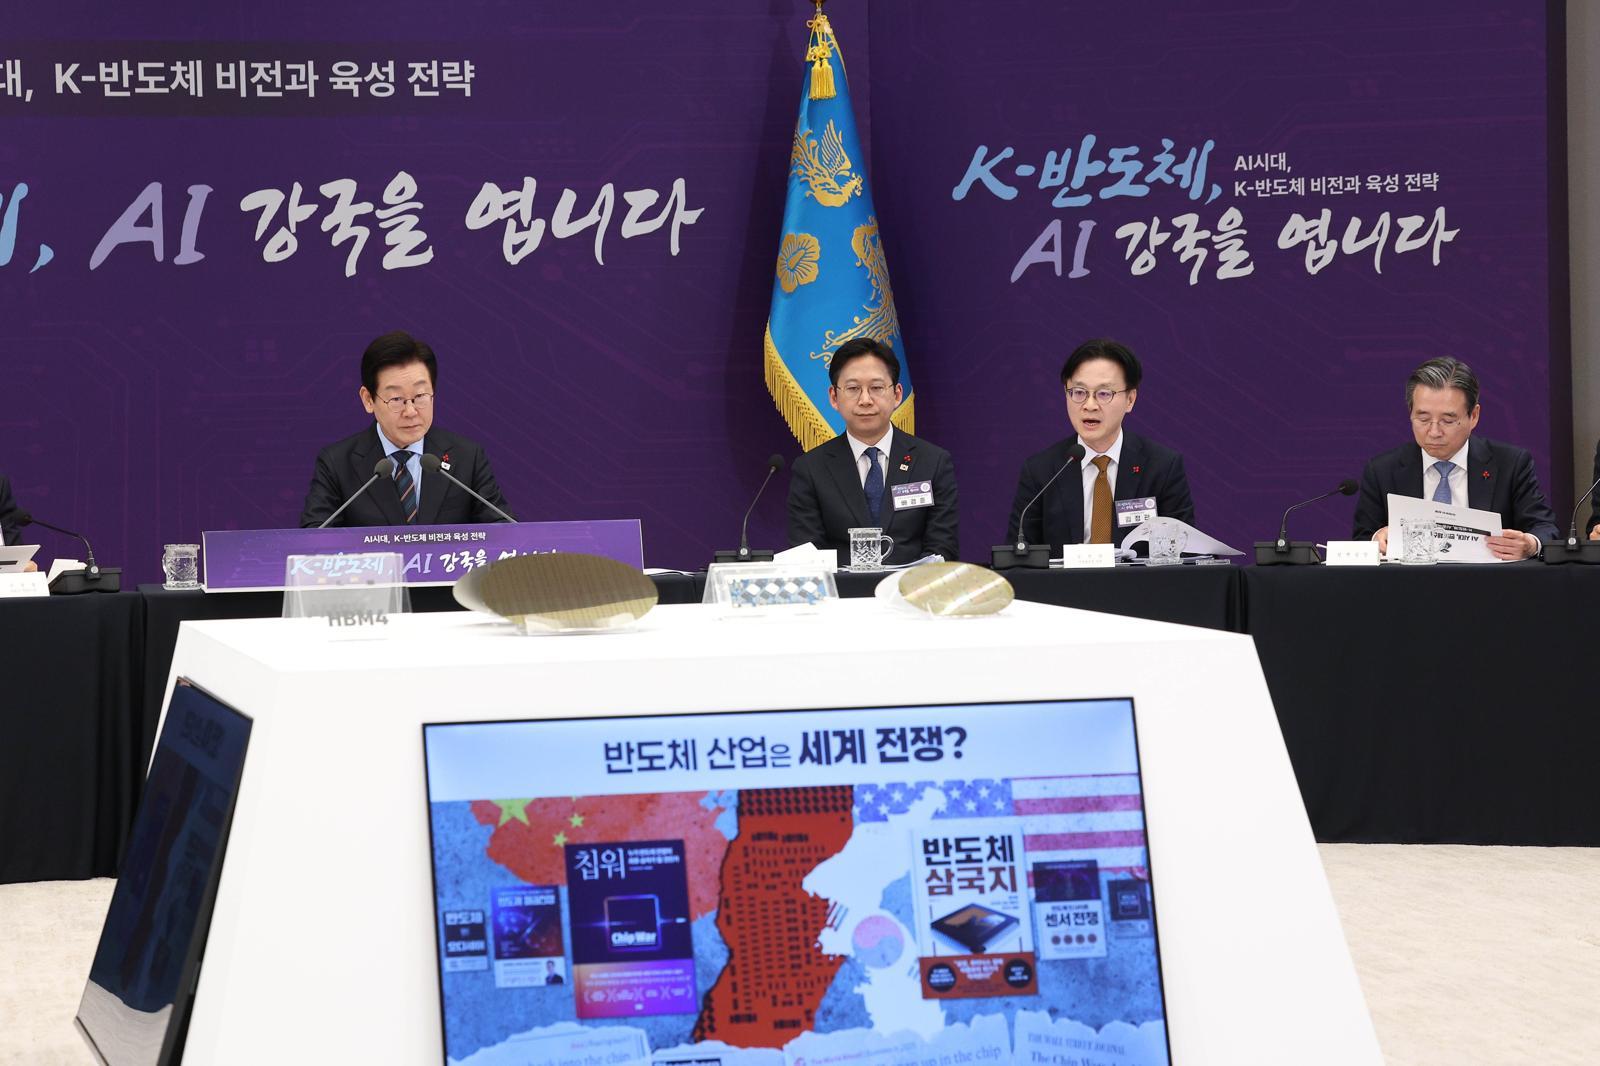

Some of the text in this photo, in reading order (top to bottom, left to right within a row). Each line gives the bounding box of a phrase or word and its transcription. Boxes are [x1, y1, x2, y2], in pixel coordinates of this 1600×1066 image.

[55, 60, 203, 98] K-반도체
[216, 60, 319, 98] 비전과
[329, 60, 395, 98] 육성
[407, 60, 475, 97] 전략
[952, 134, 1221, 208] K-반도체,
[1234, 152, 1292, 173] AI시대,
[1234, 172, 1439, 197] K-반도체 비전과 육성 전략
[90, 182, 213, 270] AI
[239, 171, 434, 278] 강국을
[465, 176, 705, 266] 엽니다
[1010, 206, 1461, 286] AI 강국을 엽니다
[364, 532, 486, 544] AI시대, K-반도체 비전과 육성 전략
[402, 552, 433, 575] AI
[328, 608, 390, 628] HBM4
[604, 725, 968, 774] 반도체 산업은 세계 전쟁?
[922, 834, 1015, 866] 반도체
[925, 864, 1018, 896] 삼국지
